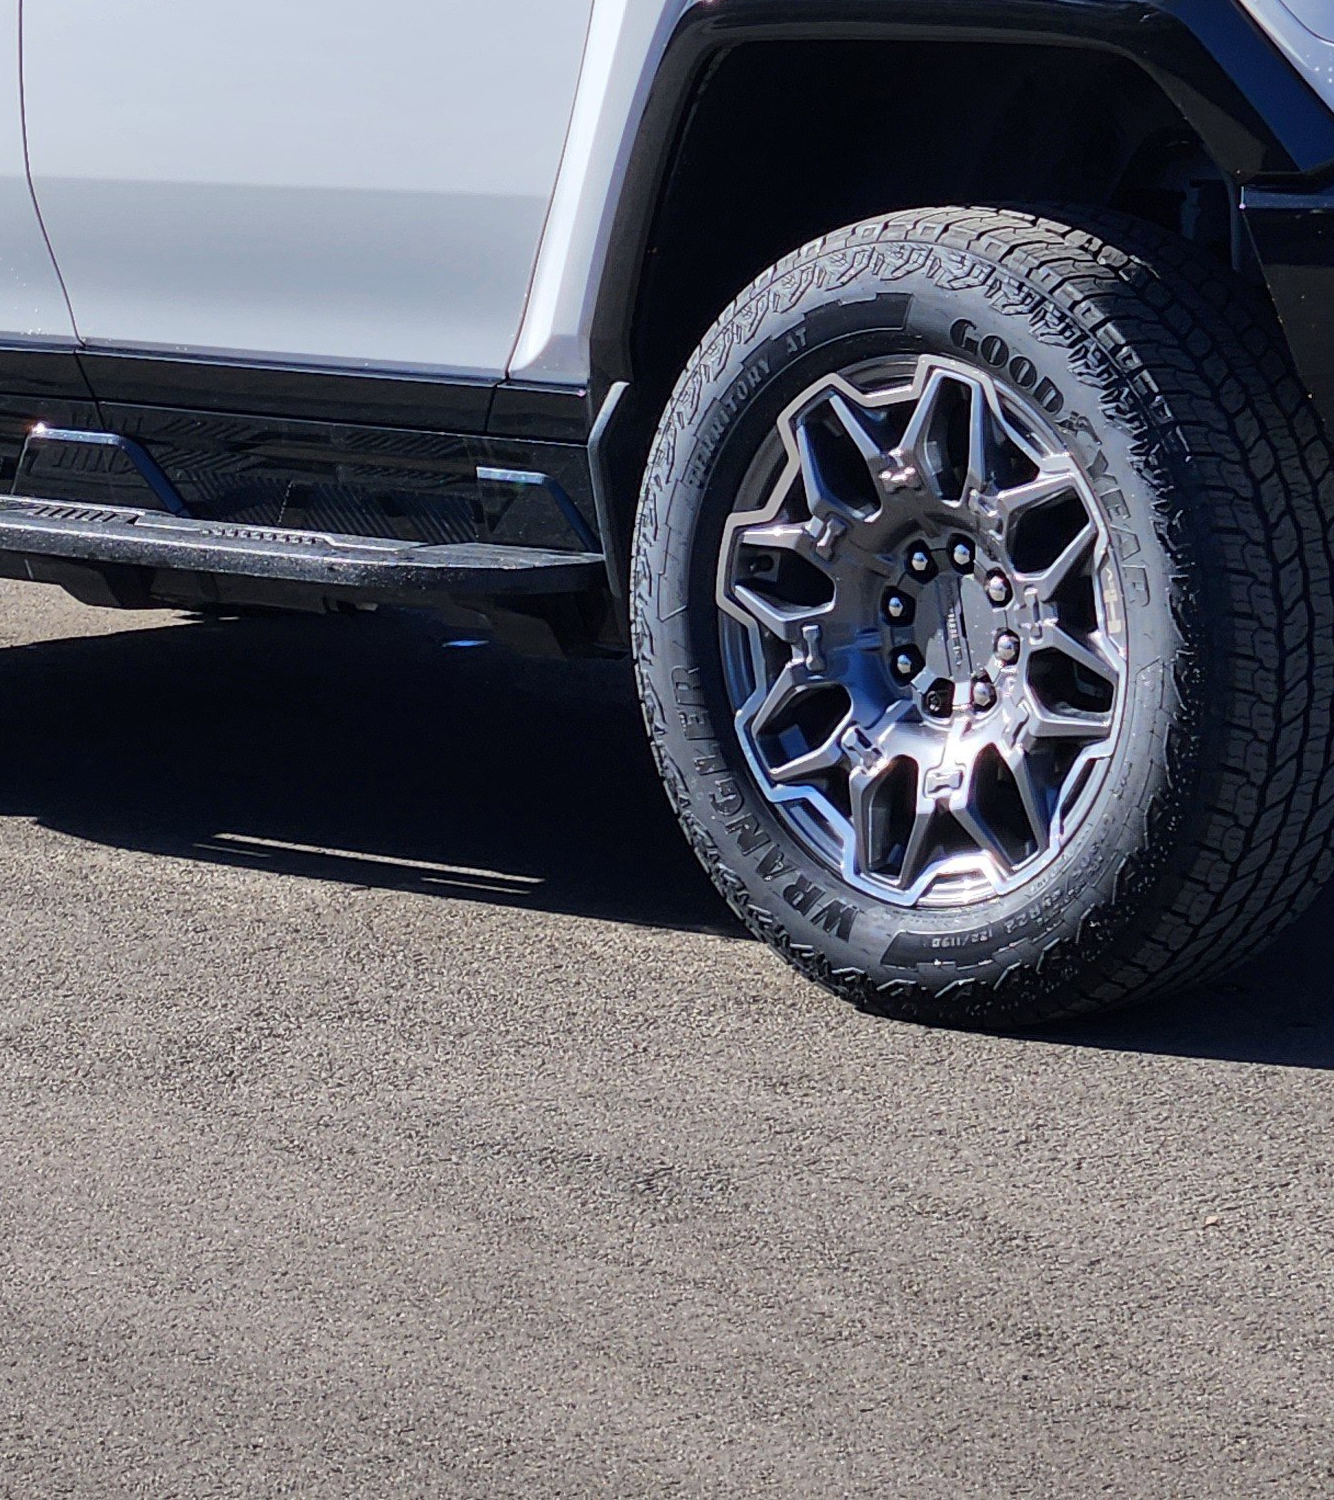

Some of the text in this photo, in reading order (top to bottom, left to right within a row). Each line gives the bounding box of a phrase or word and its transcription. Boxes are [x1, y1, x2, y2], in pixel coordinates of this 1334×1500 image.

[688, 326, 808, 489] TERRITORY AT
[671, 665, 860, 943] WRANGLER
